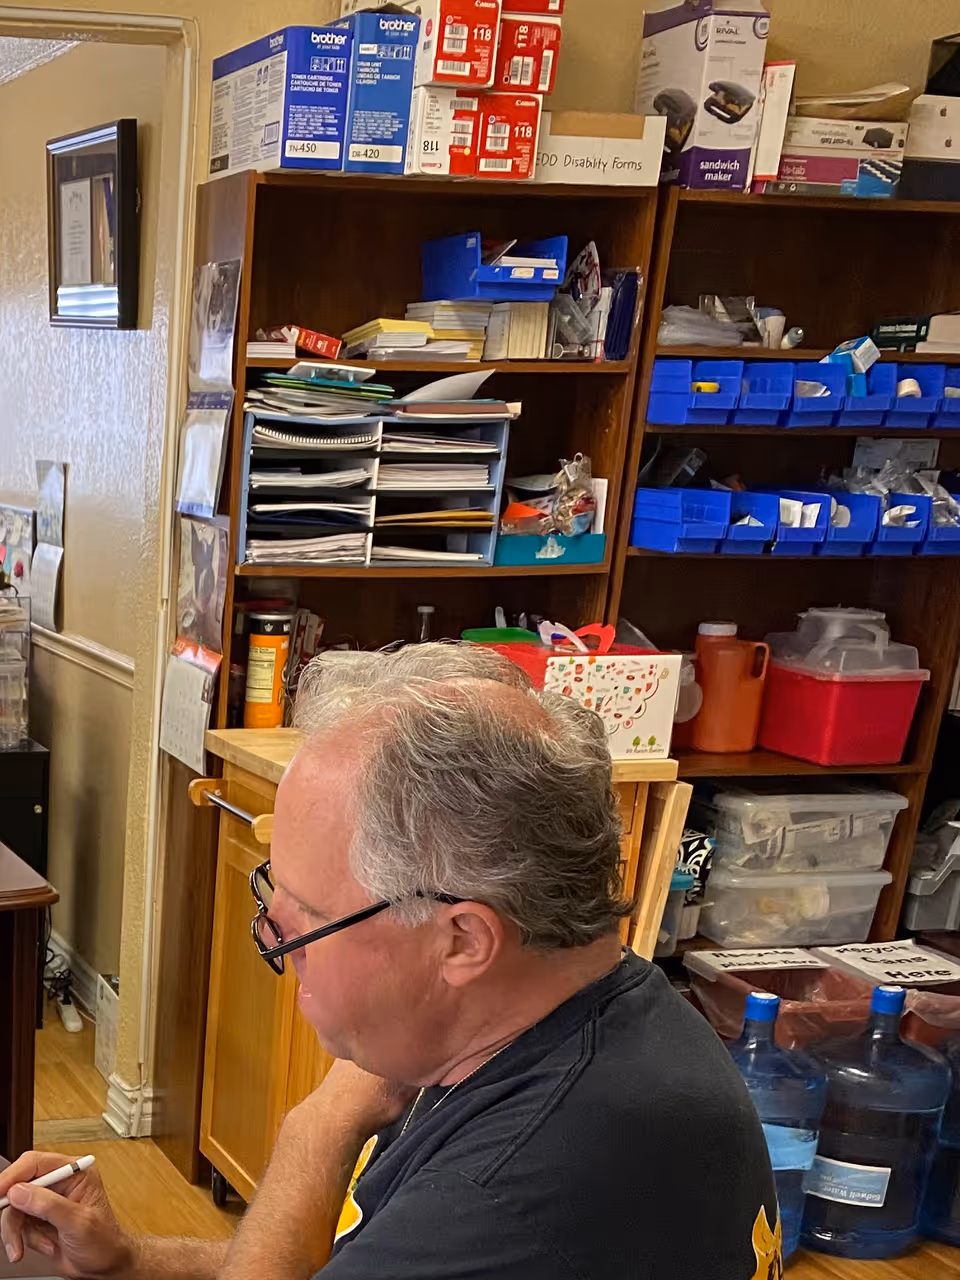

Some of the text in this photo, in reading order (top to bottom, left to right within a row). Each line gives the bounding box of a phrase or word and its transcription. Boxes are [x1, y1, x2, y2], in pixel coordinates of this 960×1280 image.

[474, 0, 496, 8] Canon
[379, 19, 416, 32] brother
[472, 28, 491, 41] 118
[716, 27, 740, 35] RIVAL
[311, 32, 347, 45] brother
[517, 25, 529, 48] 118
[514, 126, 533, 138] 118
[289, 143, 317, 153] TN-450
[423, 140, 439, 151] 118
[352, 149, 379, 159] DR-420
[564, 155, 607, 173] Disability
[612, 154, 642, 170] Forms
[700, 160, 740, 170] sandwich
[704, 172, 732, 182] maker
[862, 956, 927, 964] Cans
[884, 969, 952, 979] Here
